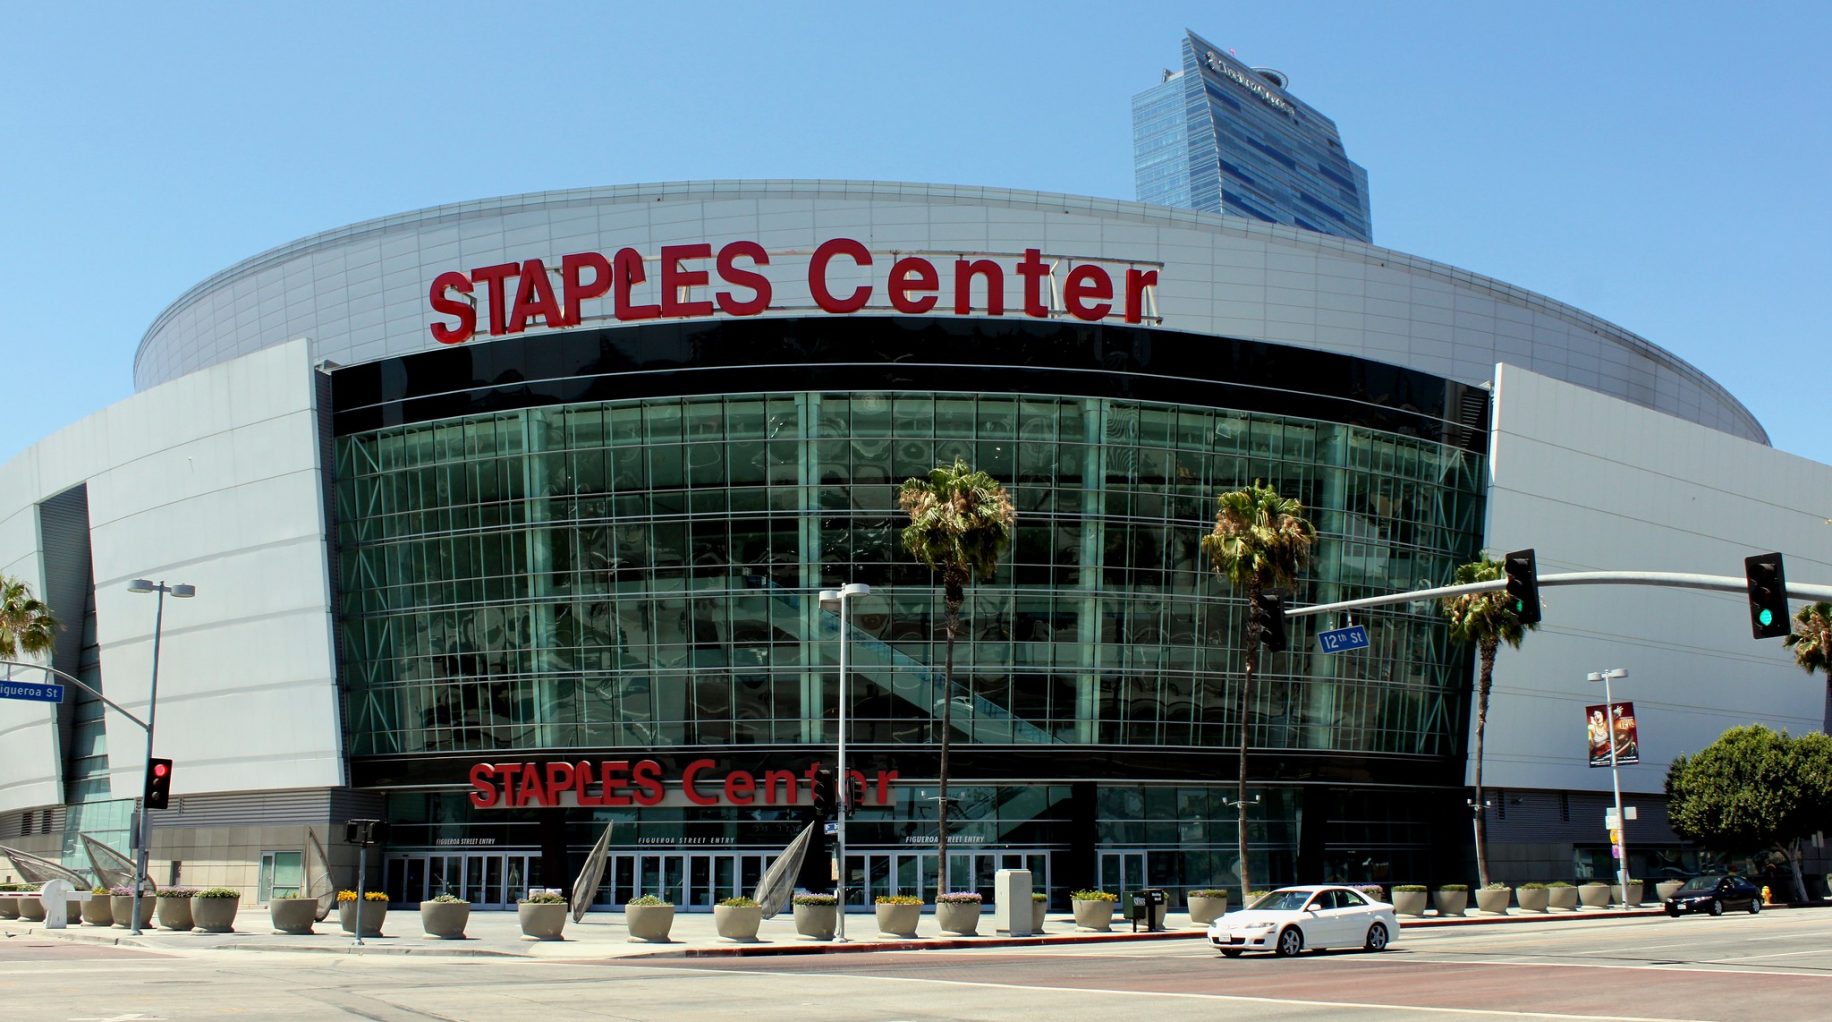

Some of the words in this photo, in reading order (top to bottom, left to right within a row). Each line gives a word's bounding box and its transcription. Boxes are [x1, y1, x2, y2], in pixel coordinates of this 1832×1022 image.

[429, 241, 773, 345] STAPLES
[808, 237, 1158, 324] Center
[1324, 634, 1347, 649] 12th
[1350, 631, 1363, 644] St
[0, 686, 42, 697] igueroa
[46, 687, 58, 698] St
[469, 759, 665, 808] STAPLES
